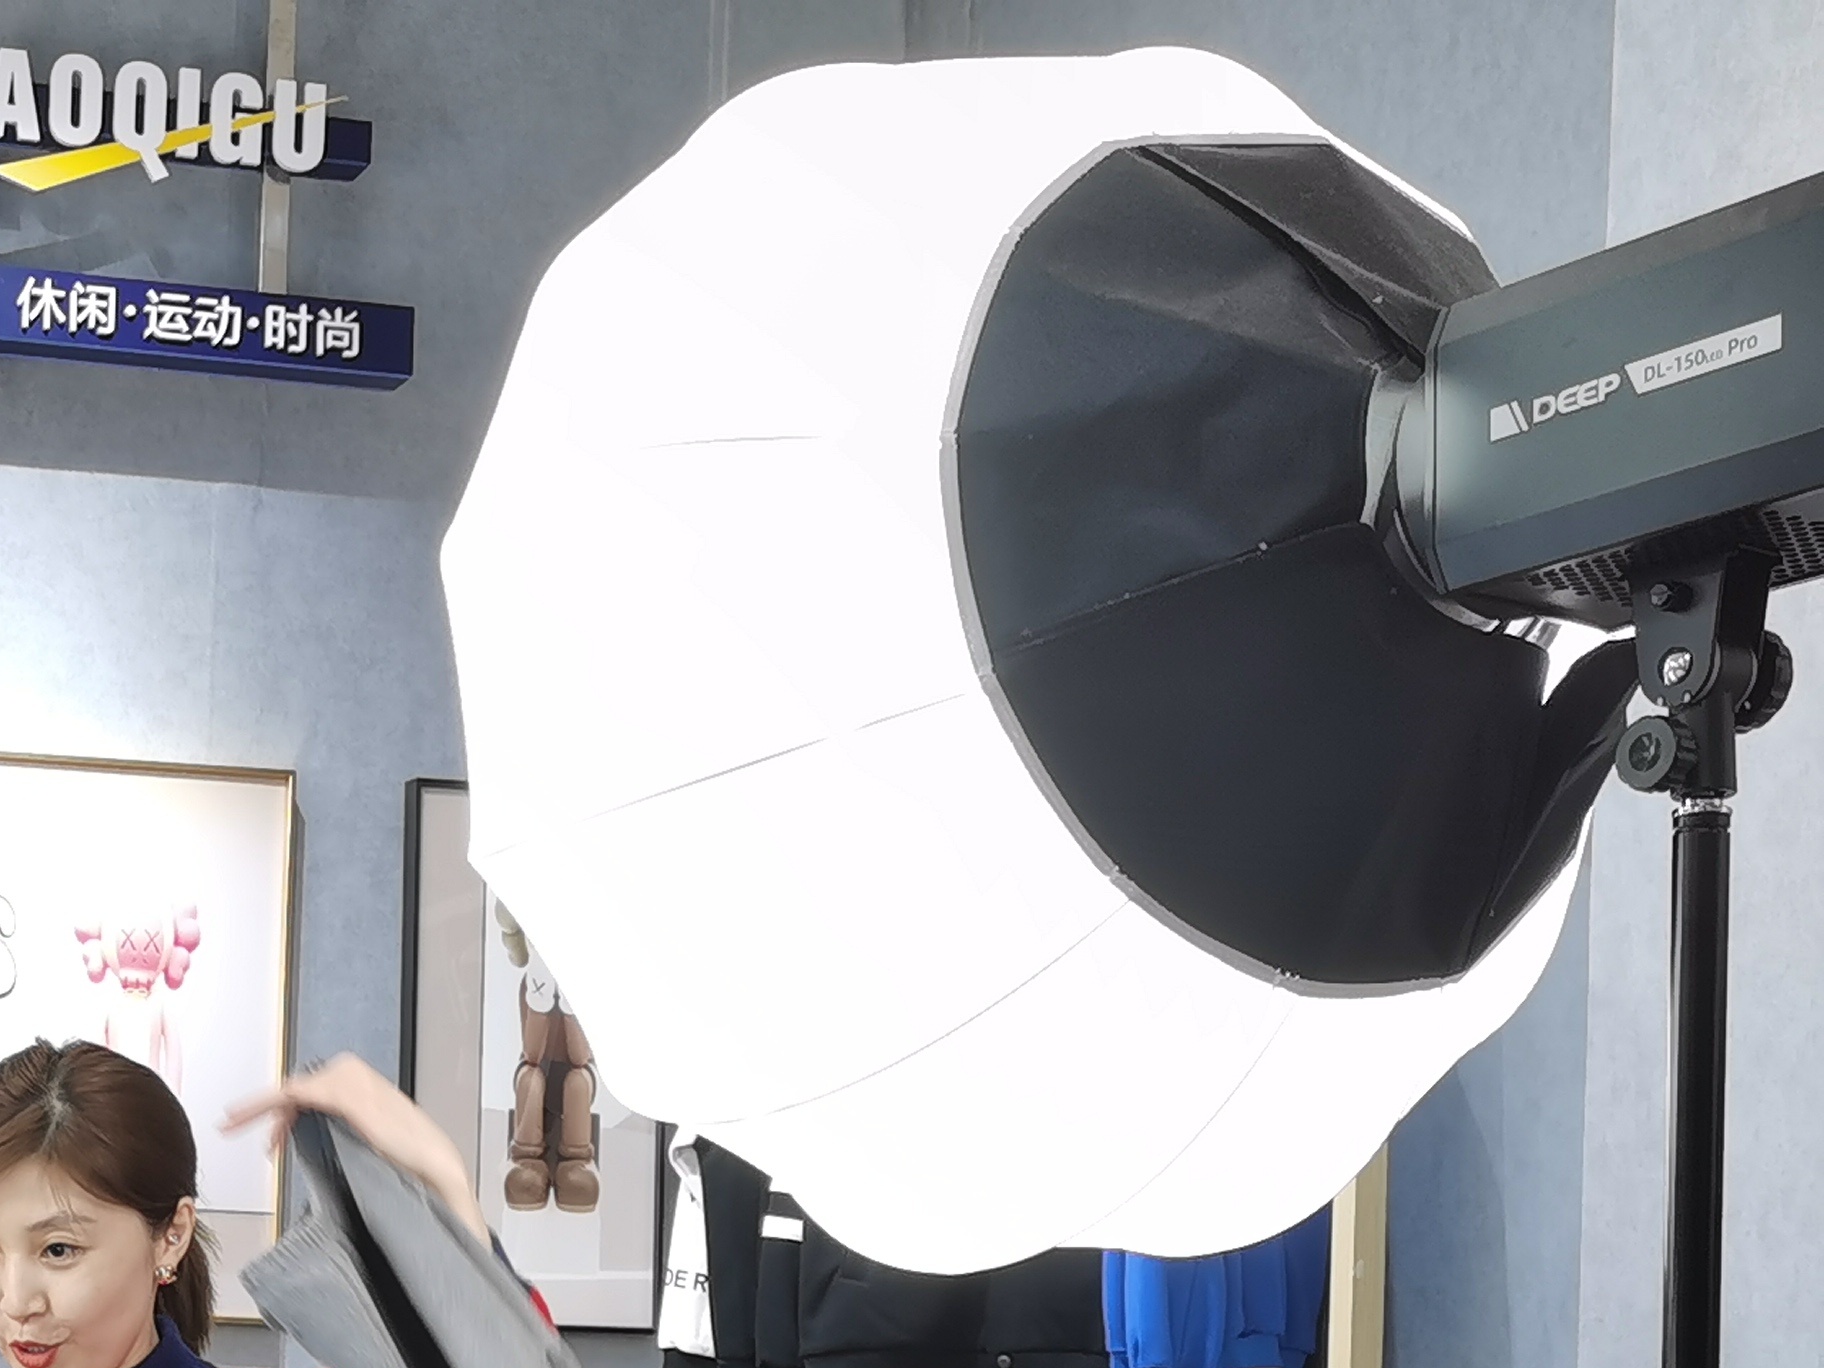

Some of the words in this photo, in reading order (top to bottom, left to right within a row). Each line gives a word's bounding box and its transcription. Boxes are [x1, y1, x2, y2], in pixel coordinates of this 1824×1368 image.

[16, 275, 362, 360] 休闲·运动·时尚
[1532, 372, 1621, 425] DEEP
[1728, 335, 1758, 357] Pro
